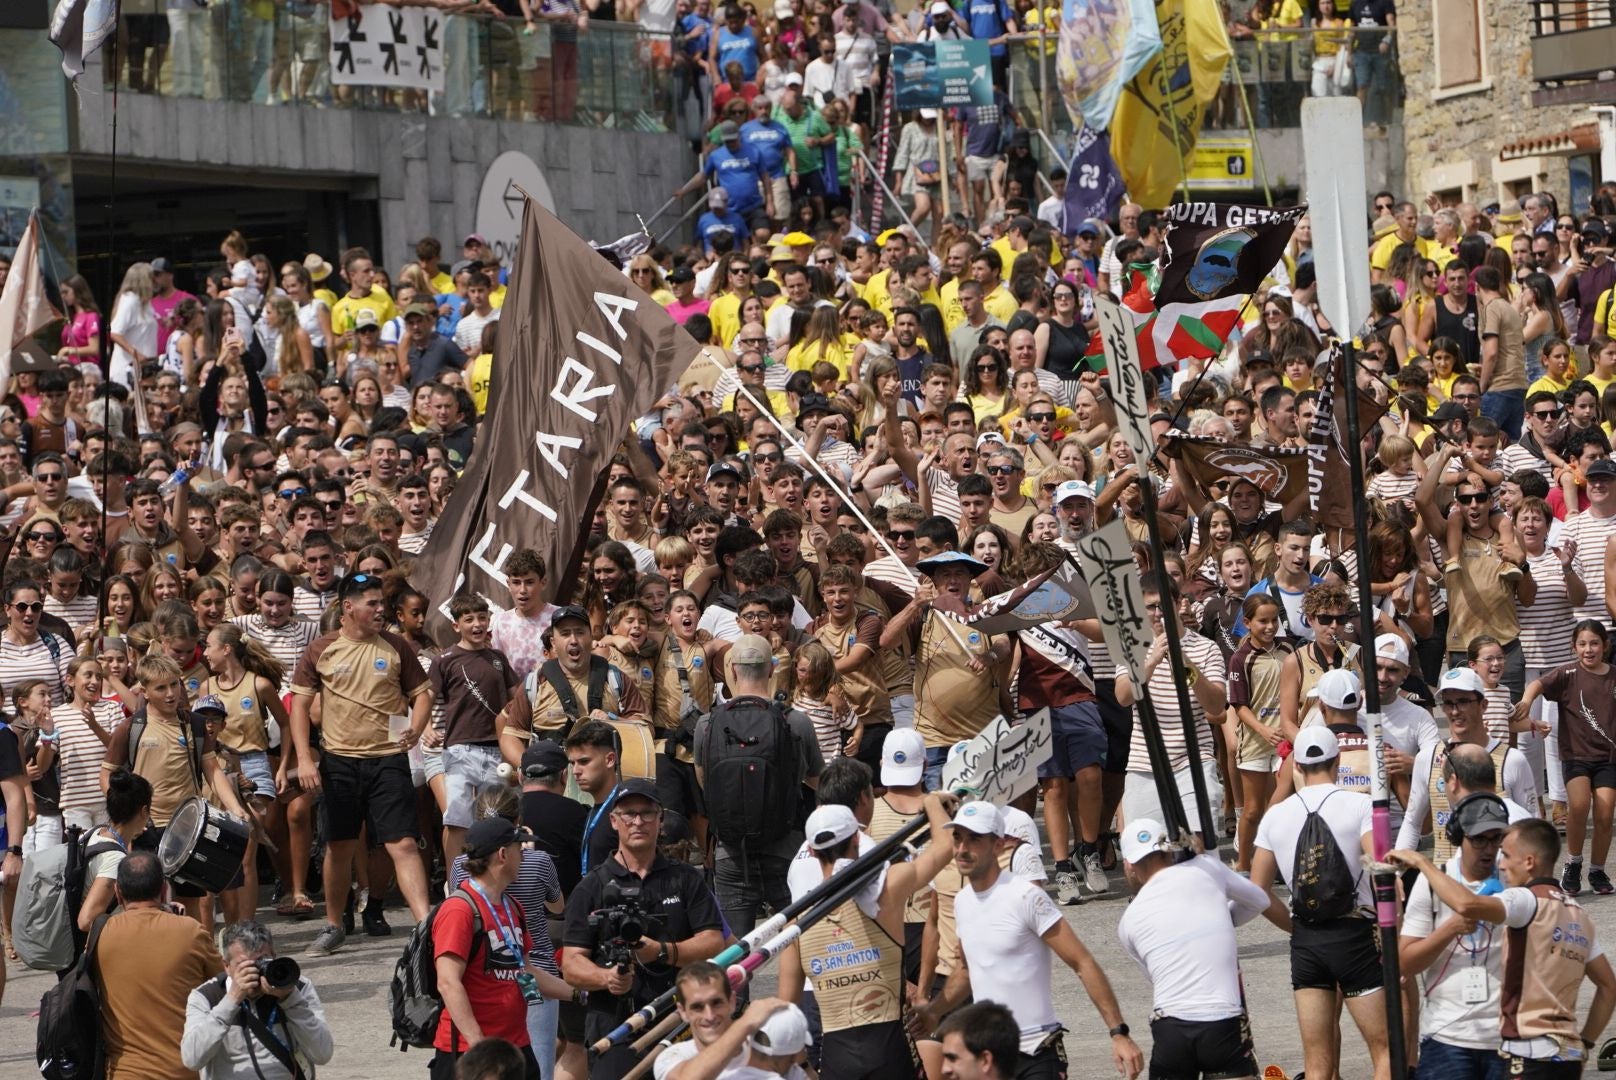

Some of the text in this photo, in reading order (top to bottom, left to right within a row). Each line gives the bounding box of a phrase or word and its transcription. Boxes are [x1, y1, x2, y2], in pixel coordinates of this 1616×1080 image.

[1375, 735, 1387, 792] INDAUX
[825, 947, 881, 970] SAN ANTON
[826, 942, 854, 953] VIVEROS
[826, 968, 882, 991] INDAUX
